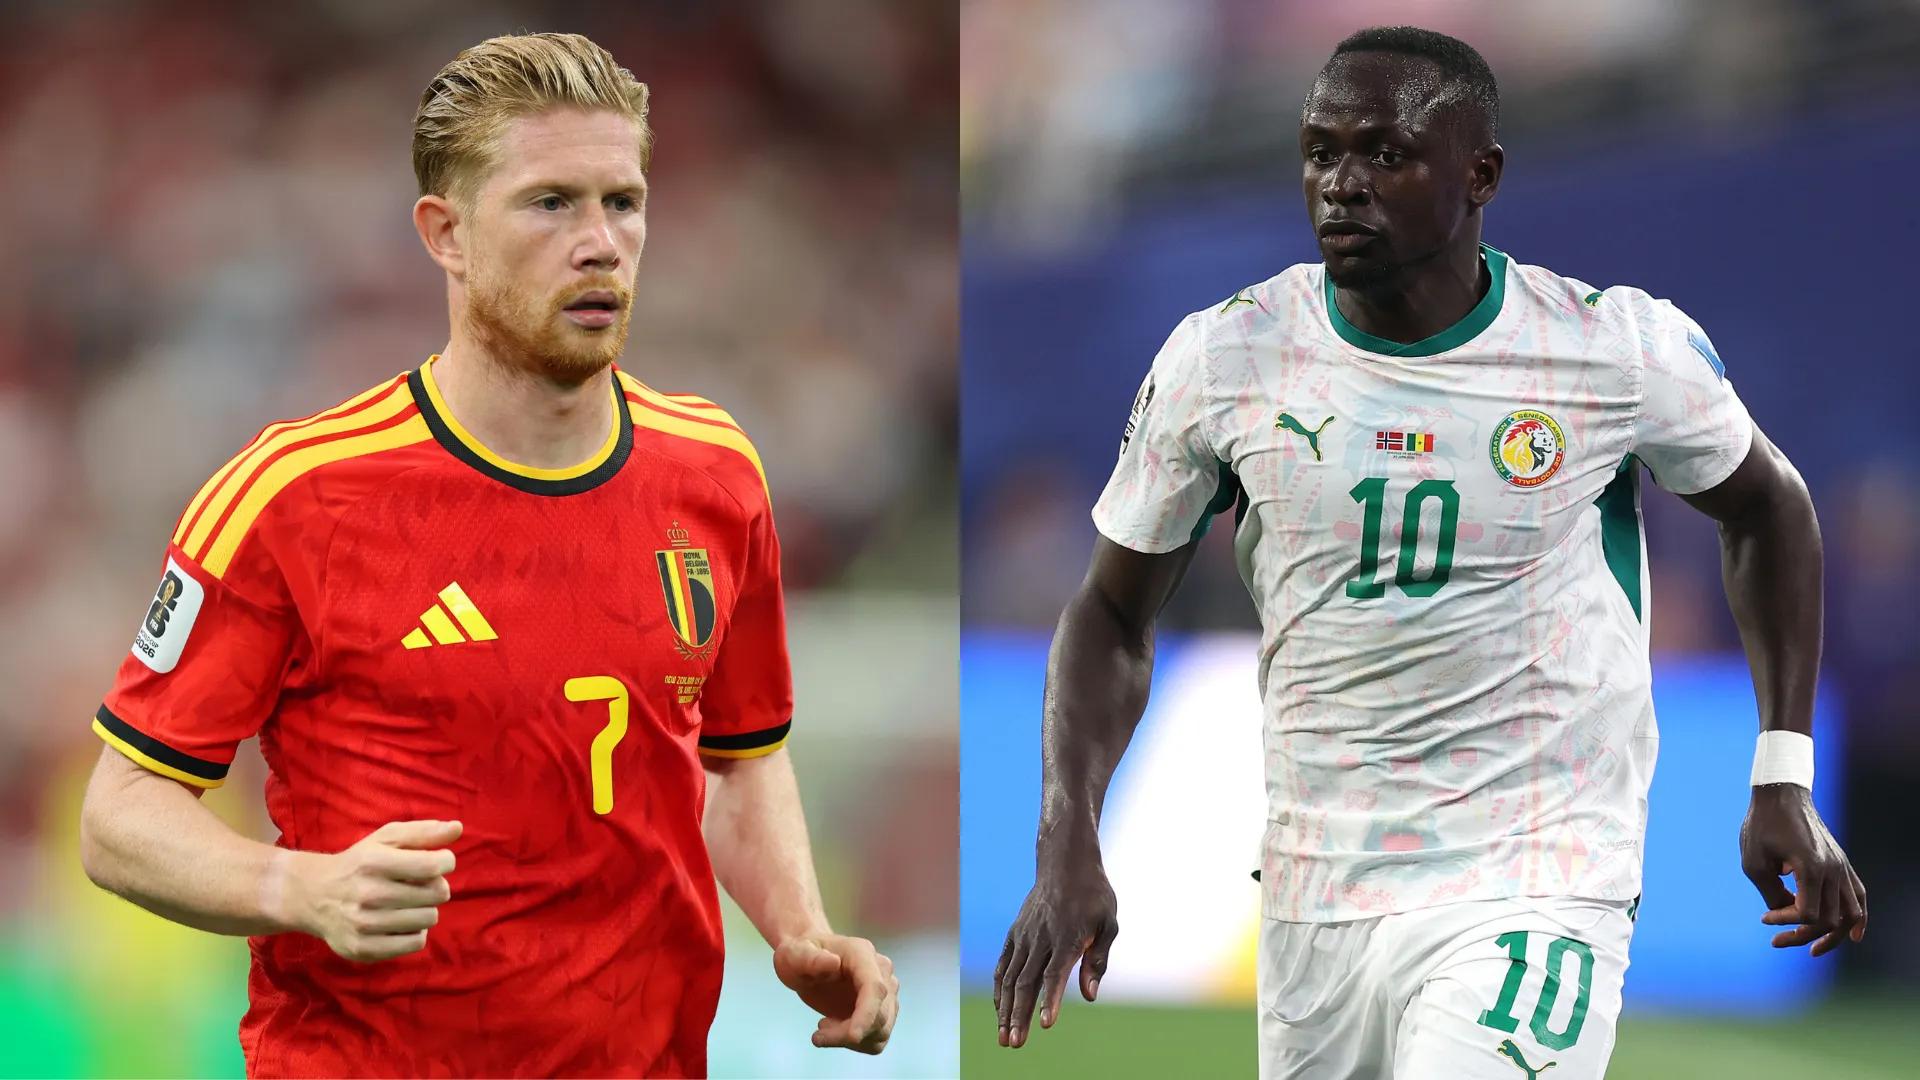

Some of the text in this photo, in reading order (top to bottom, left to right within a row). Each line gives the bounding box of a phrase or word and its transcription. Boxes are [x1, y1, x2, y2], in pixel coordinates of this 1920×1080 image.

[1517, 468, 1555, 485] FOOTBALL
[1345, 477, 1461, 599] 10
[135, 635, 156, 659] 2026
[563, 675, 629, 816] 7
[1476, 930, 1596, 1051] 10
